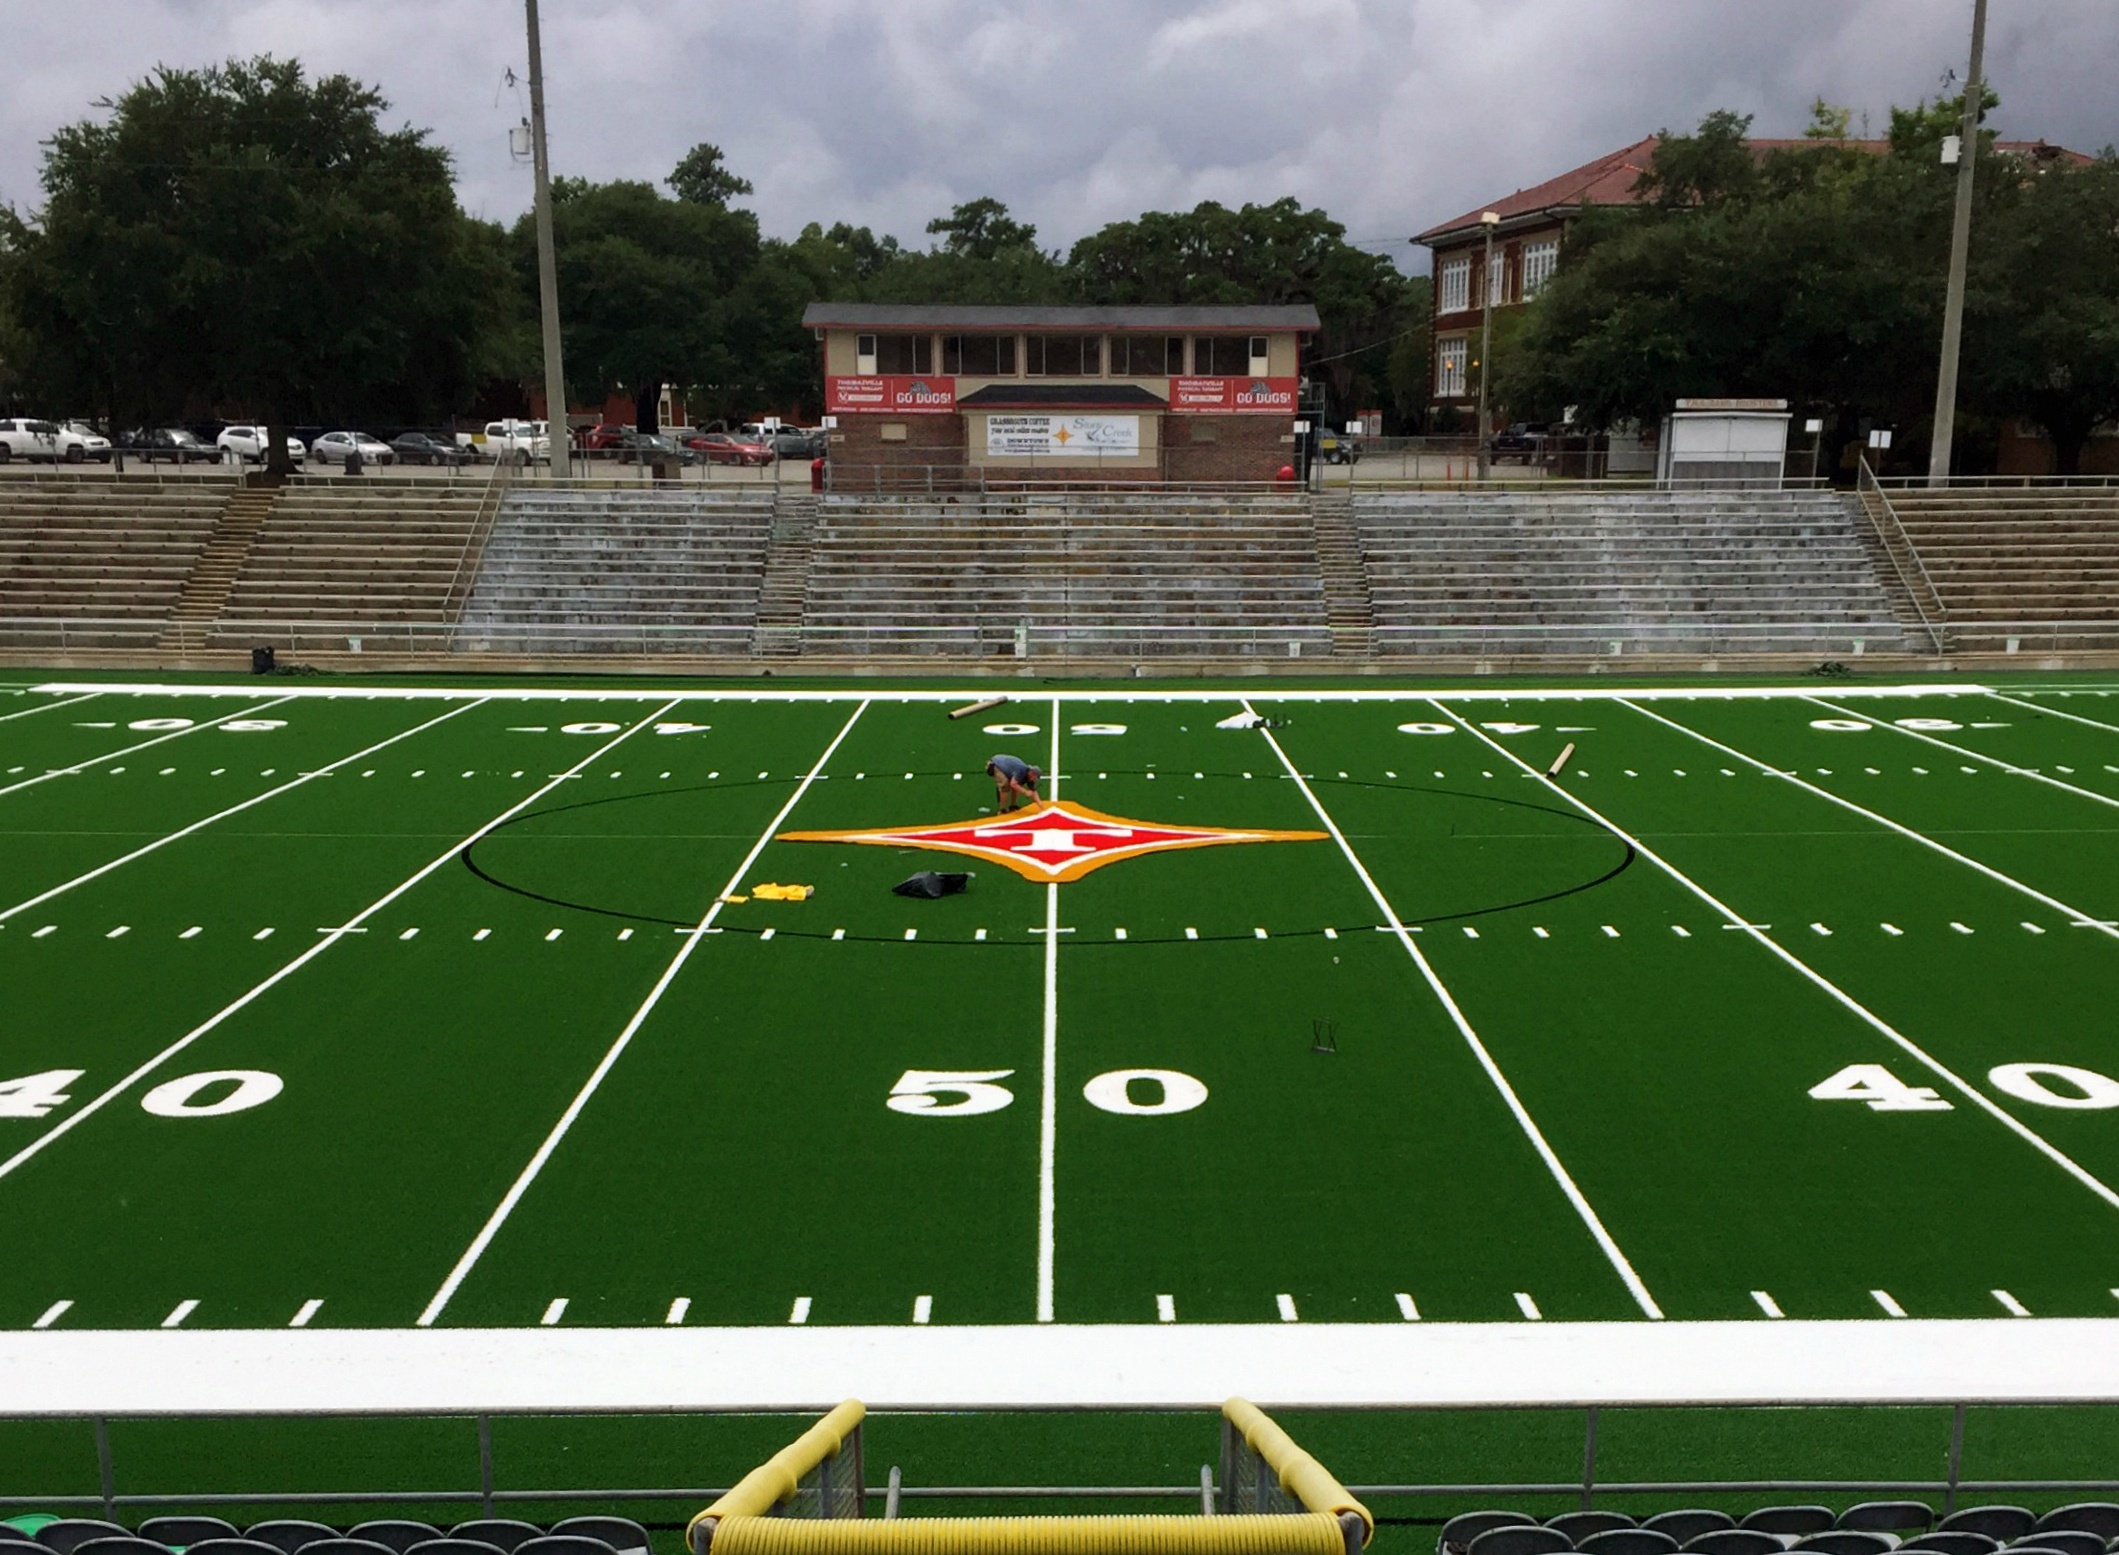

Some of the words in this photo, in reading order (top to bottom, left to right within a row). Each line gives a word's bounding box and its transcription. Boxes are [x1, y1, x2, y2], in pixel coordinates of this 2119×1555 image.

[897, 392, 913, 404] GO
[916, 392, 952, 404] DOGS!
[1236, 392, 1253, 404] GO
[1255, 392, 1291, 404] DOGS!
[1029, 417, 1051, 425] COFFEE
